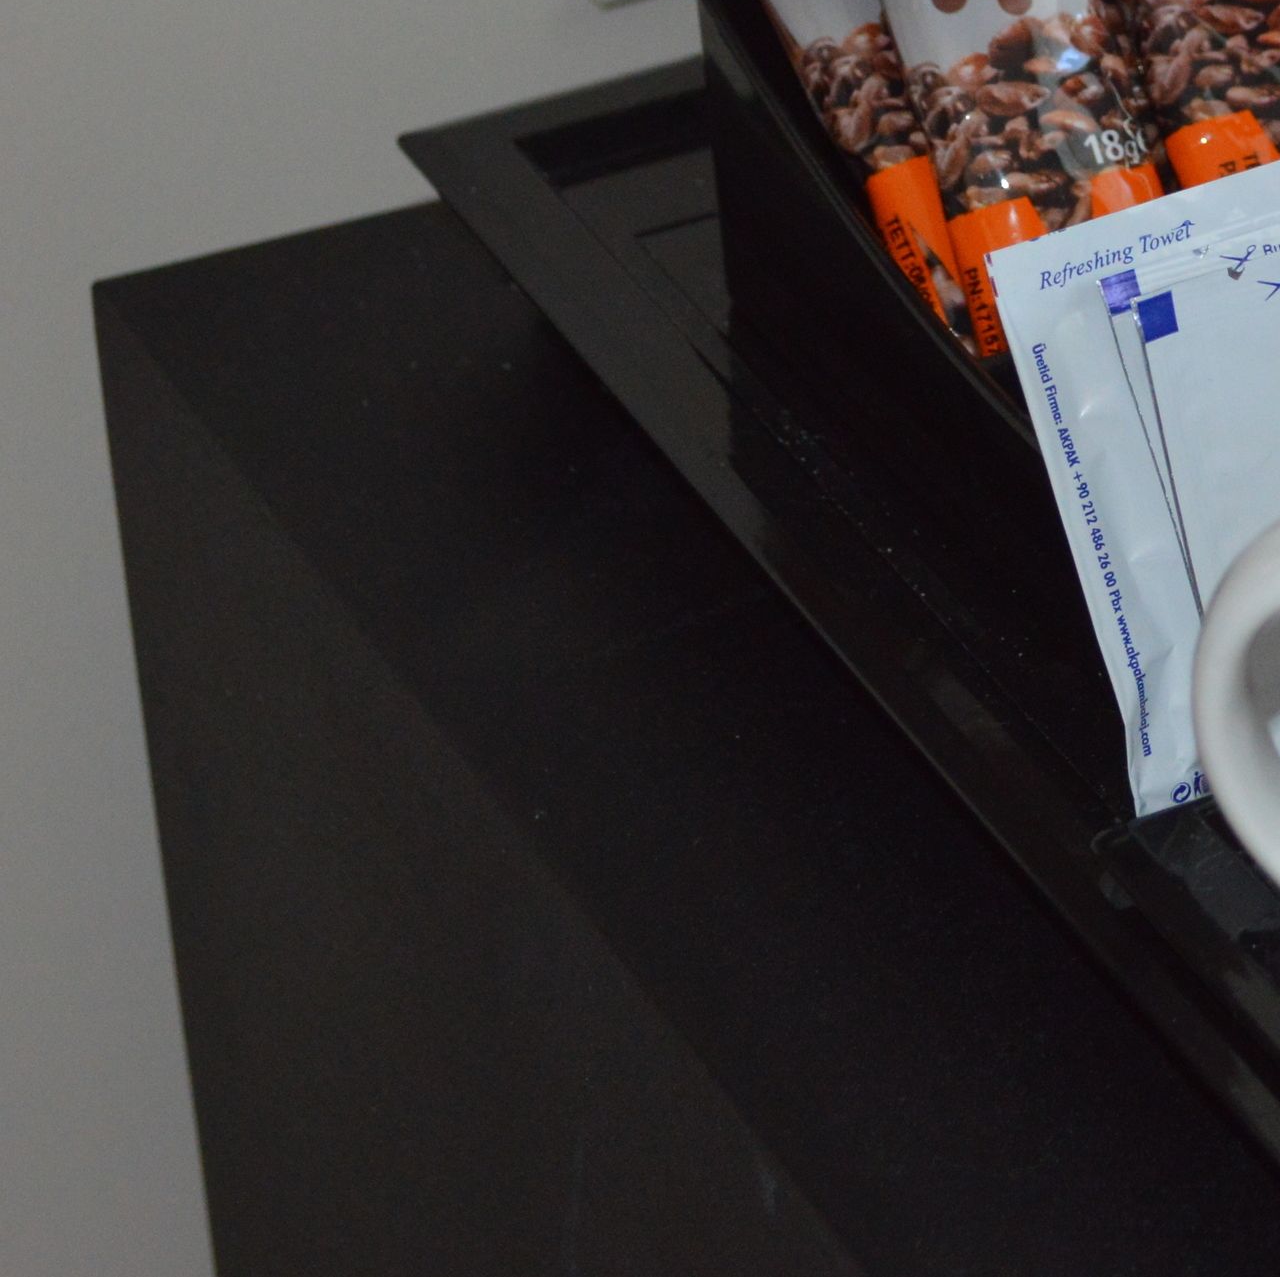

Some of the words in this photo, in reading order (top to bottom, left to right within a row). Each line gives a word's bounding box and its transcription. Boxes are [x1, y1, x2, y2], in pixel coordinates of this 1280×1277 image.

[1039, 245, 1134, 291] Refreshing
[1139, 220, 1193, 254] Towel
[1044, 384, 1063, 426] Firma:
[1057, 427, 1081, 468] AKPAK
[1073, 471, 1090, 499] +90
[1081, 500, 1098, 526] 212
[1090, 527, 1105, 551] 486
[1097, 552, 1112, 570] 26
[1103, 571, 1117, 588] 00
[1109, 588, 1123, 614] Pbx
[1117, 614, 1153, 758] www.akpakambalaj.com
